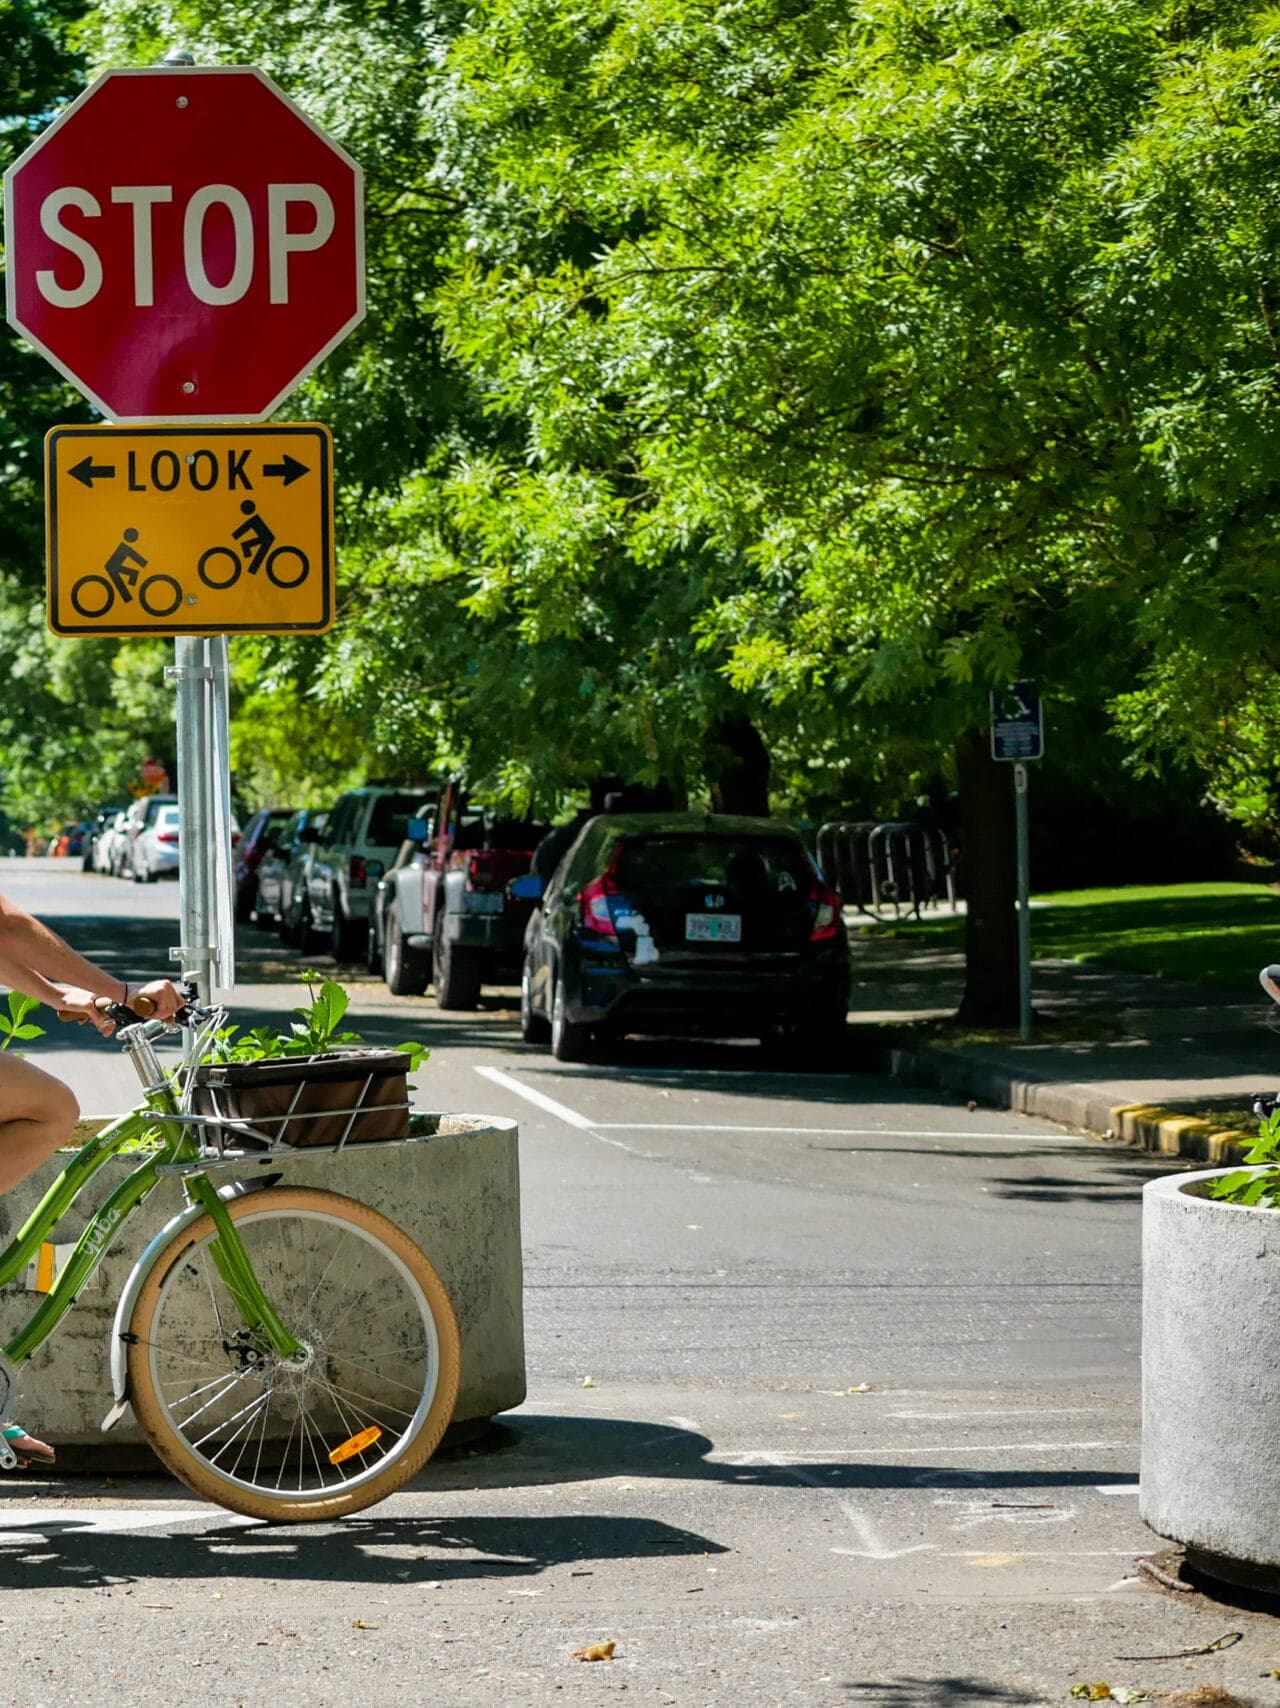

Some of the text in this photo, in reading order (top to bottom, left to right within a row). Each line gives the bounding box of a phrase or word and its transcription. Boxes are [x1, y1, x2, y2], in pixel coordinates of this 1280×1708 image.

[36, 183, 335, 308] STOP
[128, 450, 254, 492] LOOK
[80, 1129, 122, 1167] BODA BODA
[82, 1207, 123, 1255] yuba
